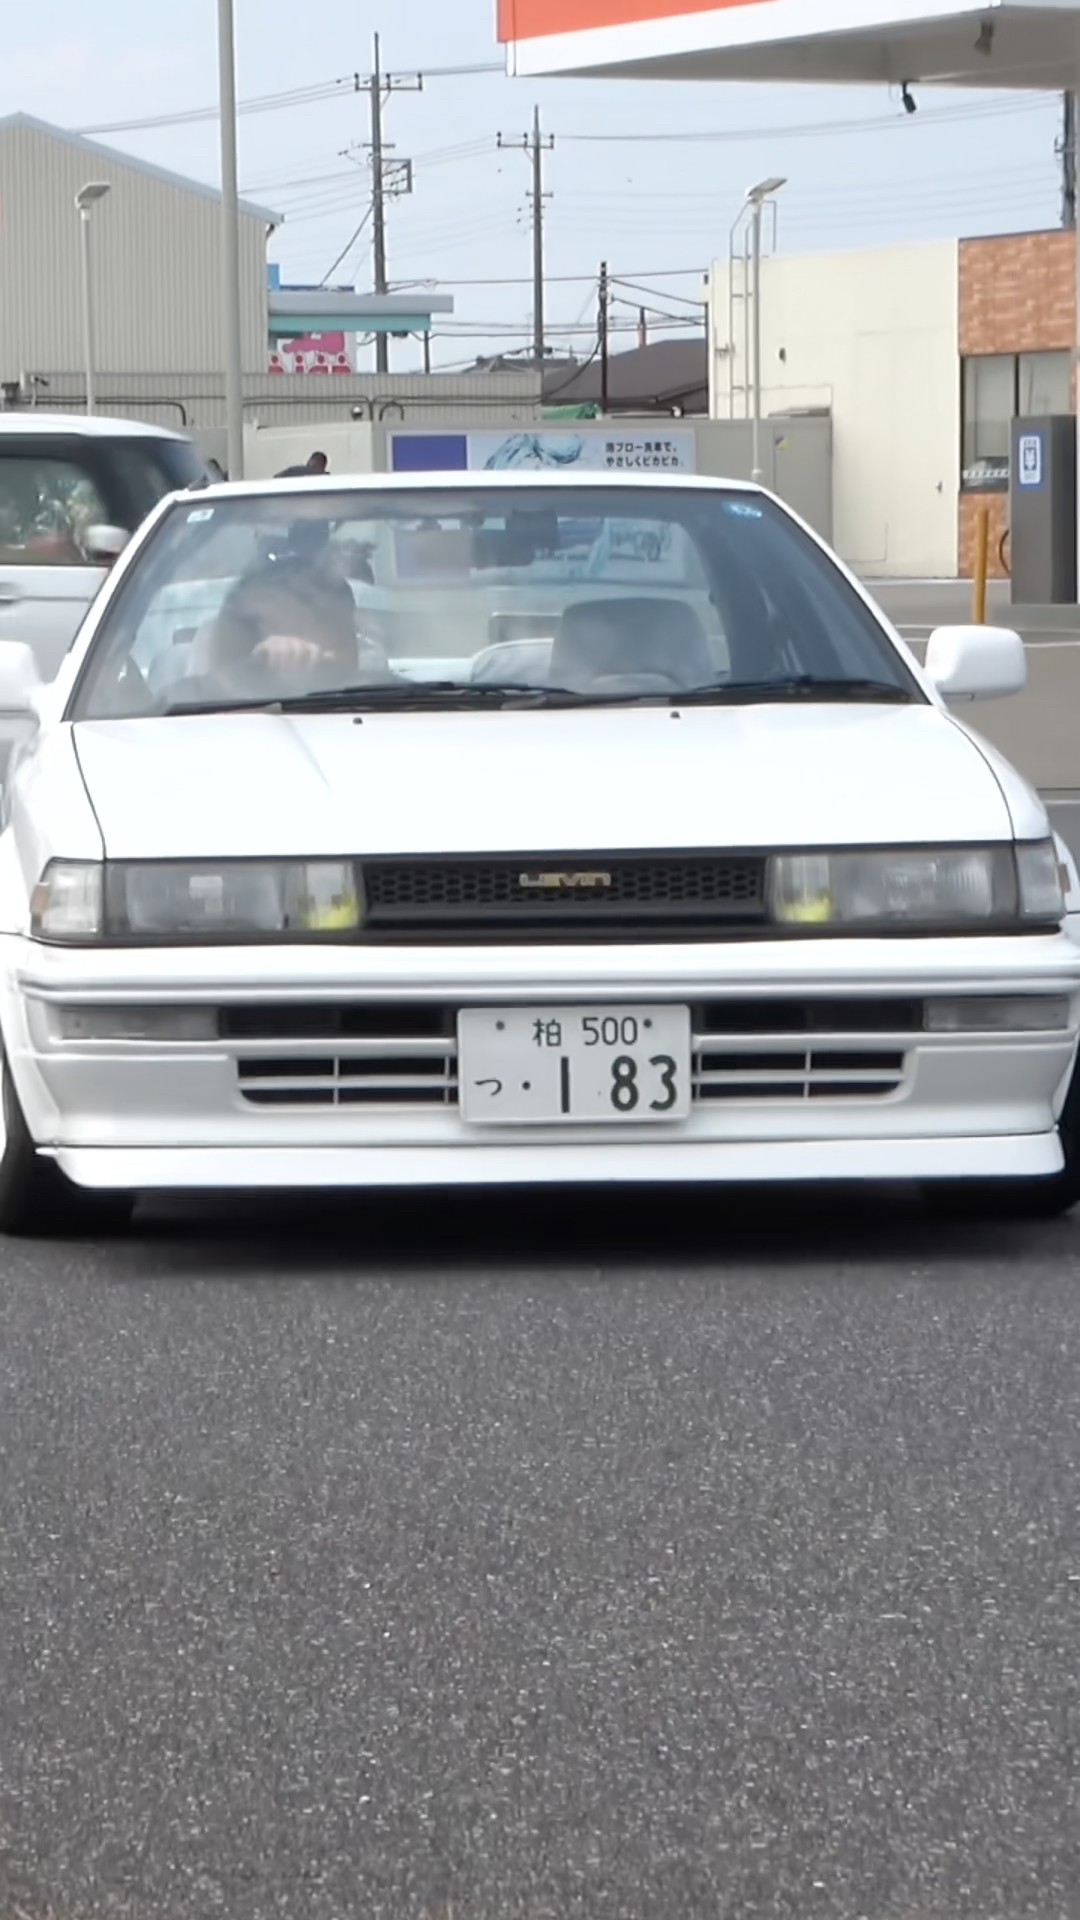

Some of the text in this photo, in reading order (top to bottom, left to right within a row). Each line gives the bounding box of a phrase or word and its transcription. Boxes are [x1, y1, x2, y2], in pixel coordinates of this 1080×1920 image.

[532, 1016, 638, 1047] 柏 500
[474, 1078, 502, 1096] つ
